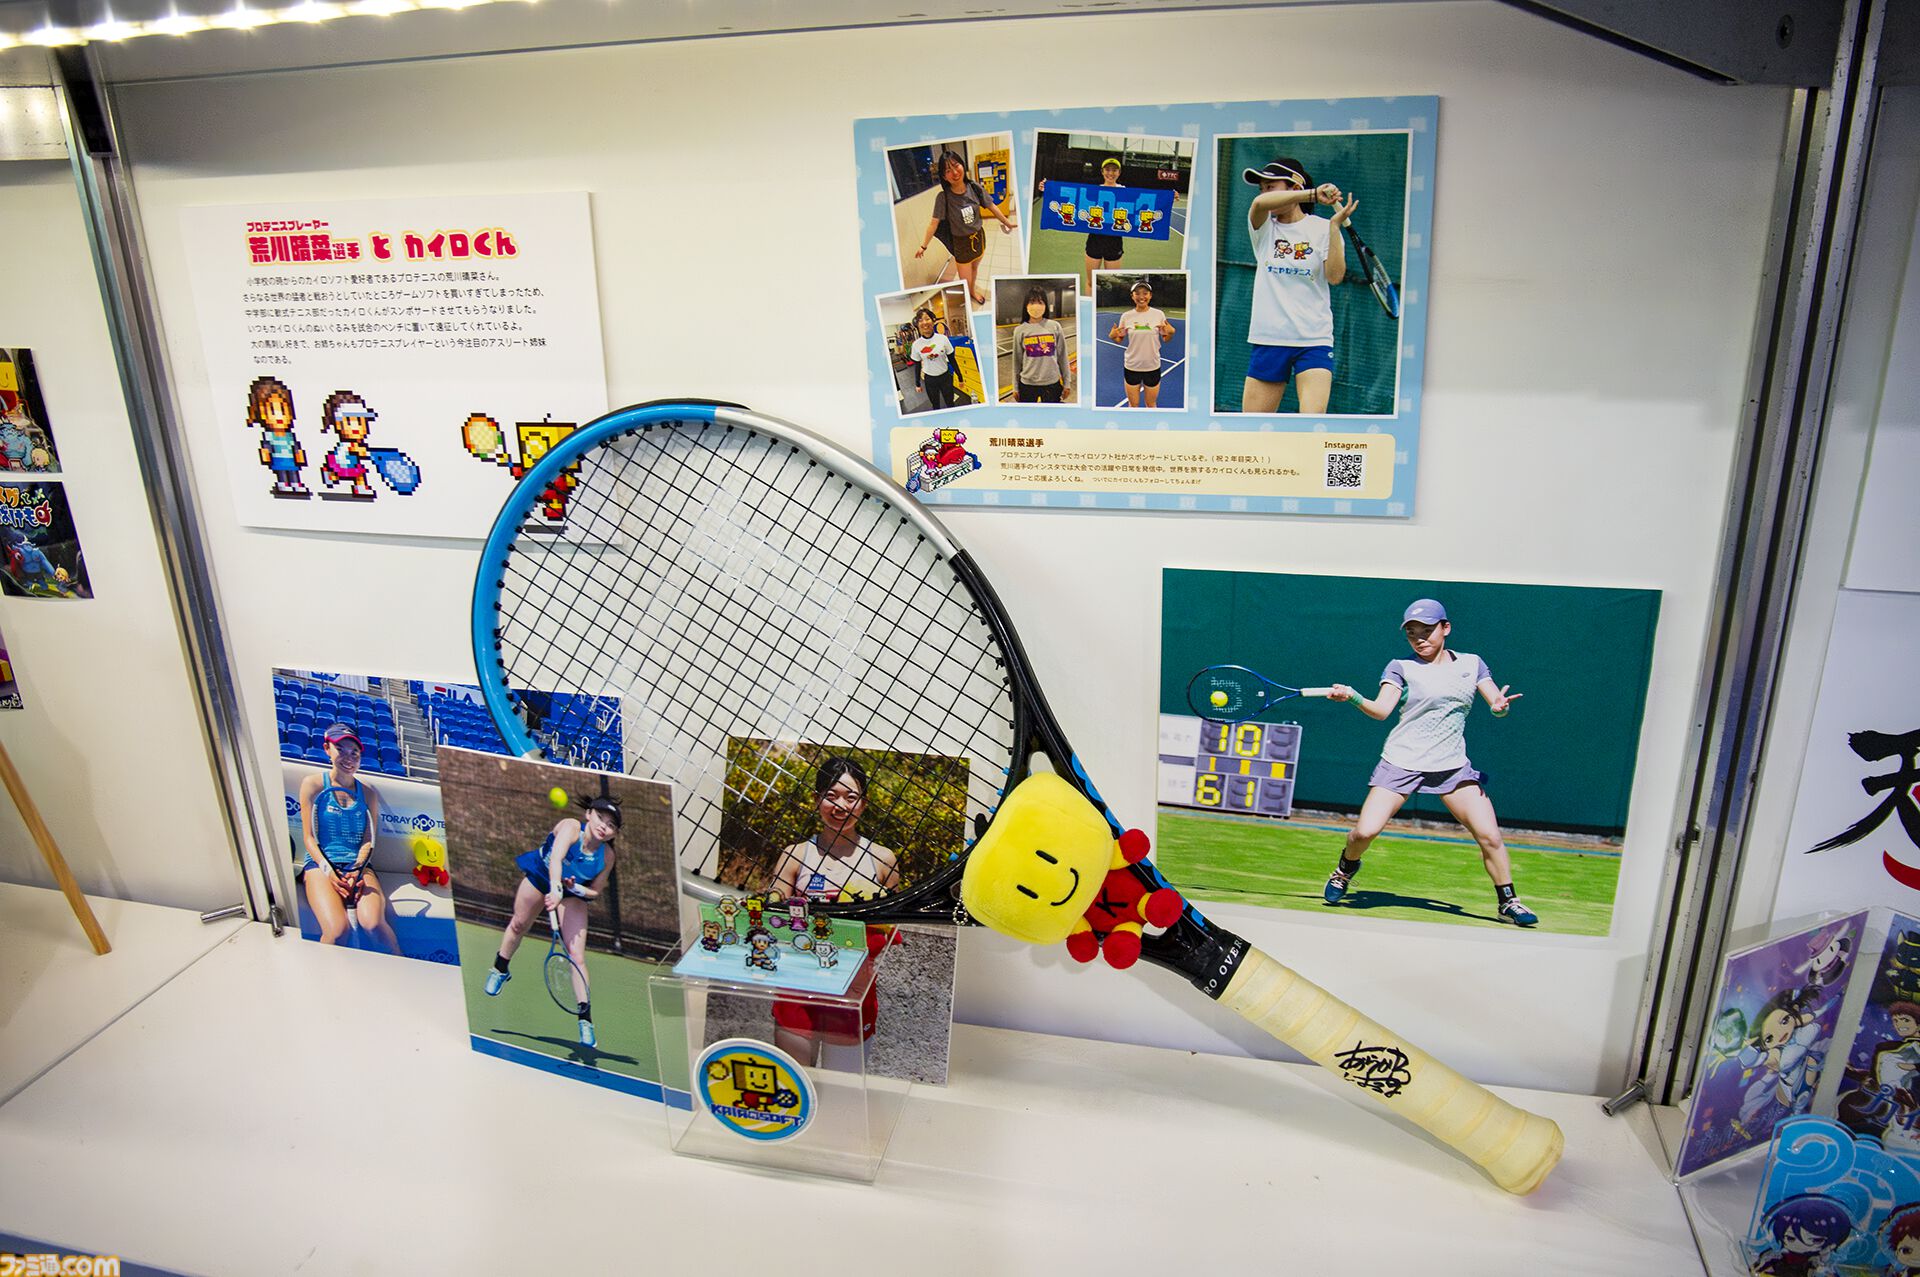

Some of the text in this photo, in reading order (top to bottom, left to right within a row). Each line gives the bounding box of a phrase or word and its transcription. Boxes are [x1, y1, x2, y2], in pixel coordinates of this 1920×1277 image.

[246, 220, 329, 233] プロテニスプレーヤー
[249, 231, 517, 263] 荒川晴菜選手 と カイロくん
[253, 355, 292, 365] なのである。
[988, 437, 1045, 448] 荒川晴菜選手
[1324, 441, 1368, 450] Instagram
[1196, 774, 1221, 806] 6
[380, 813, 411, 825] TORAY
[1095, 887, 1129, 918] K
[711, 1103, 804, 1126] KAIROSOFT
